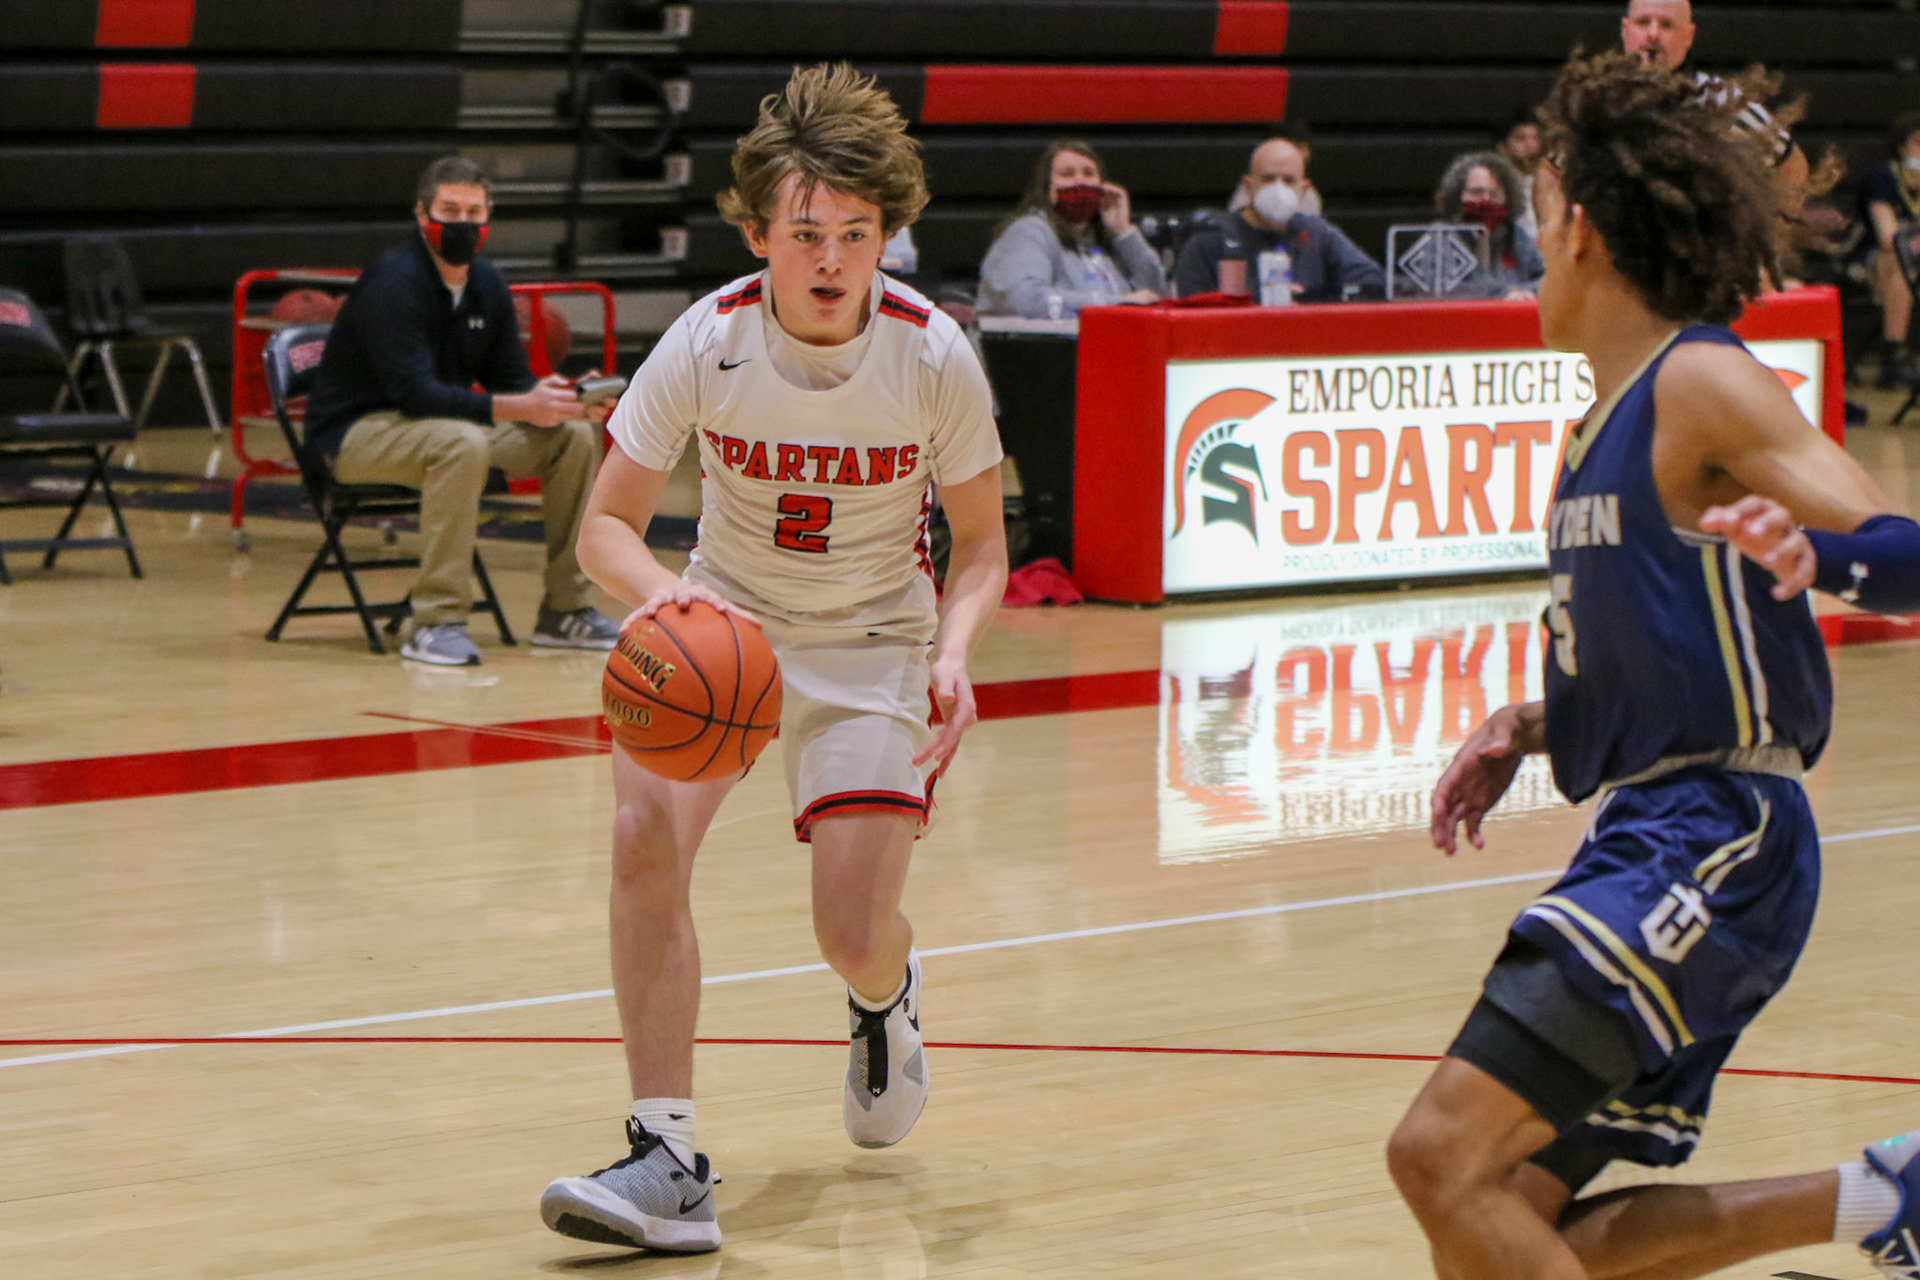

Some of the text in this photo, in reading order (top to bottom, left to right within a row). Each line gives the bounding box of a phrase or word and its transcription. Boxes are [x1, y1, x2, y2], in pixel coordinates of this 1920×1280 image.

[1287, 364, 1458, 415] EMPORIA
[1472, 361, 1563, 407] HIGH
[774, 493, 833, 553] 2
[1351, 547, 1414, 568] DONATED
